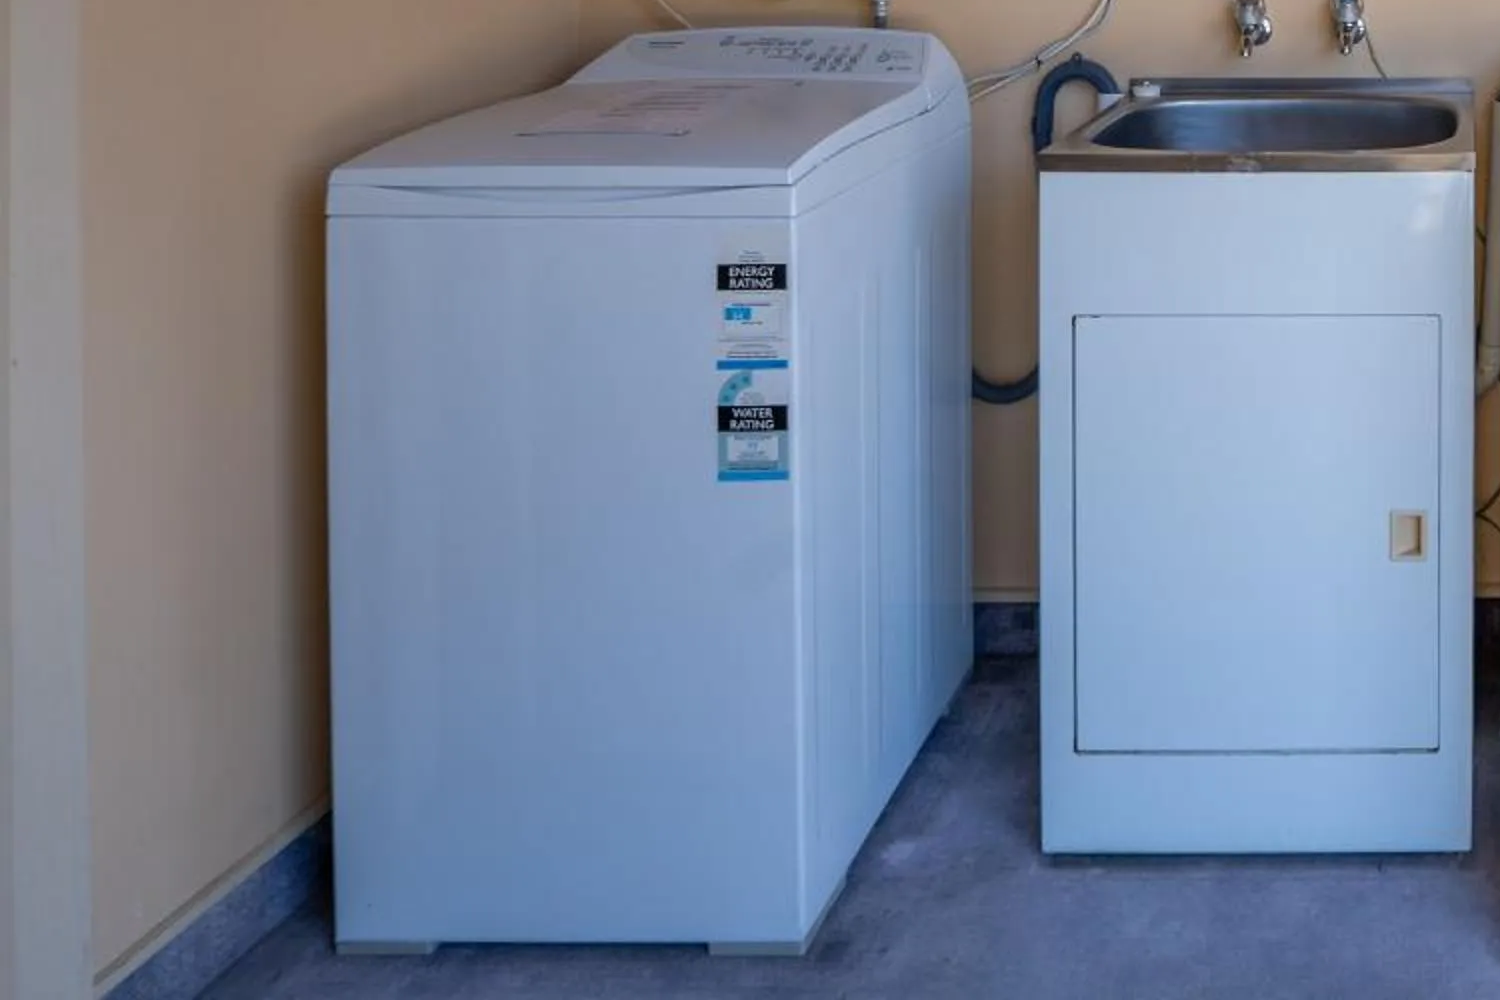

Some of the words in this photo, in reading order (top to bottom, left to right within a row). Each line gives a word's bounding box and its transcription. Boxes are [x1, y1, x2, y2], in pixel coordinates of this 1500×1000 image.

[728, 266, 775, 277] ENERGY
[728, 278, 773, 289] RATING
[731, 407, 774, 418] WATER
[729, 419, 775, 430] RATING
